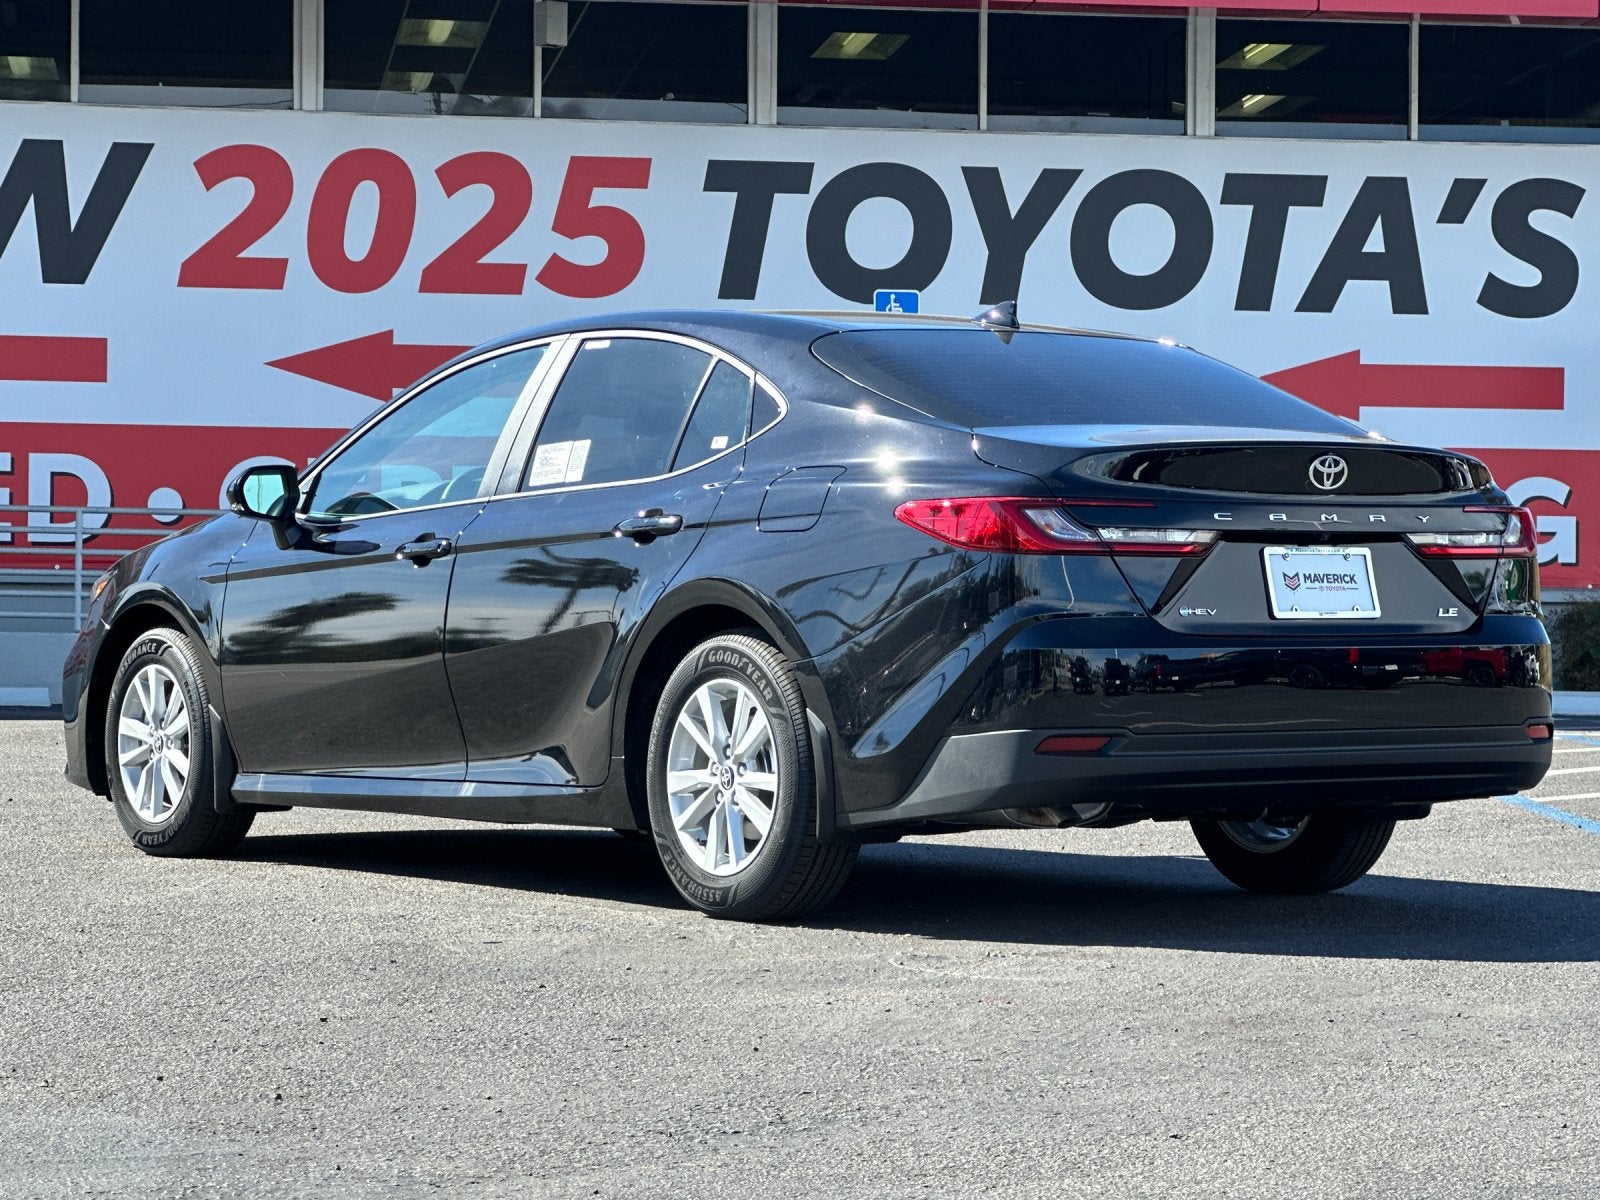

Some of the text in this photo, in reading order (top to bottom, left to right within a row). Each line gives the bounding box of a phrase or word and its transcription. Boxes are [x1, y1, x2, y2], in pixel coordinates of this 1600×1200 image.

[179, 145, 650, 298] 2025
[703, 159, 1587, 319] TOYOTA'S
[0, 452, 112, 544] D
[1213, 511, 1431, 524] CAMRY
[1303, 573, 1358, 585] MAVERICK
[1437, 607, 1459, 617] LE
[708, 650, 773, 702] GOODYEAR
[663, 850, 723, 902] ASSURANCE
